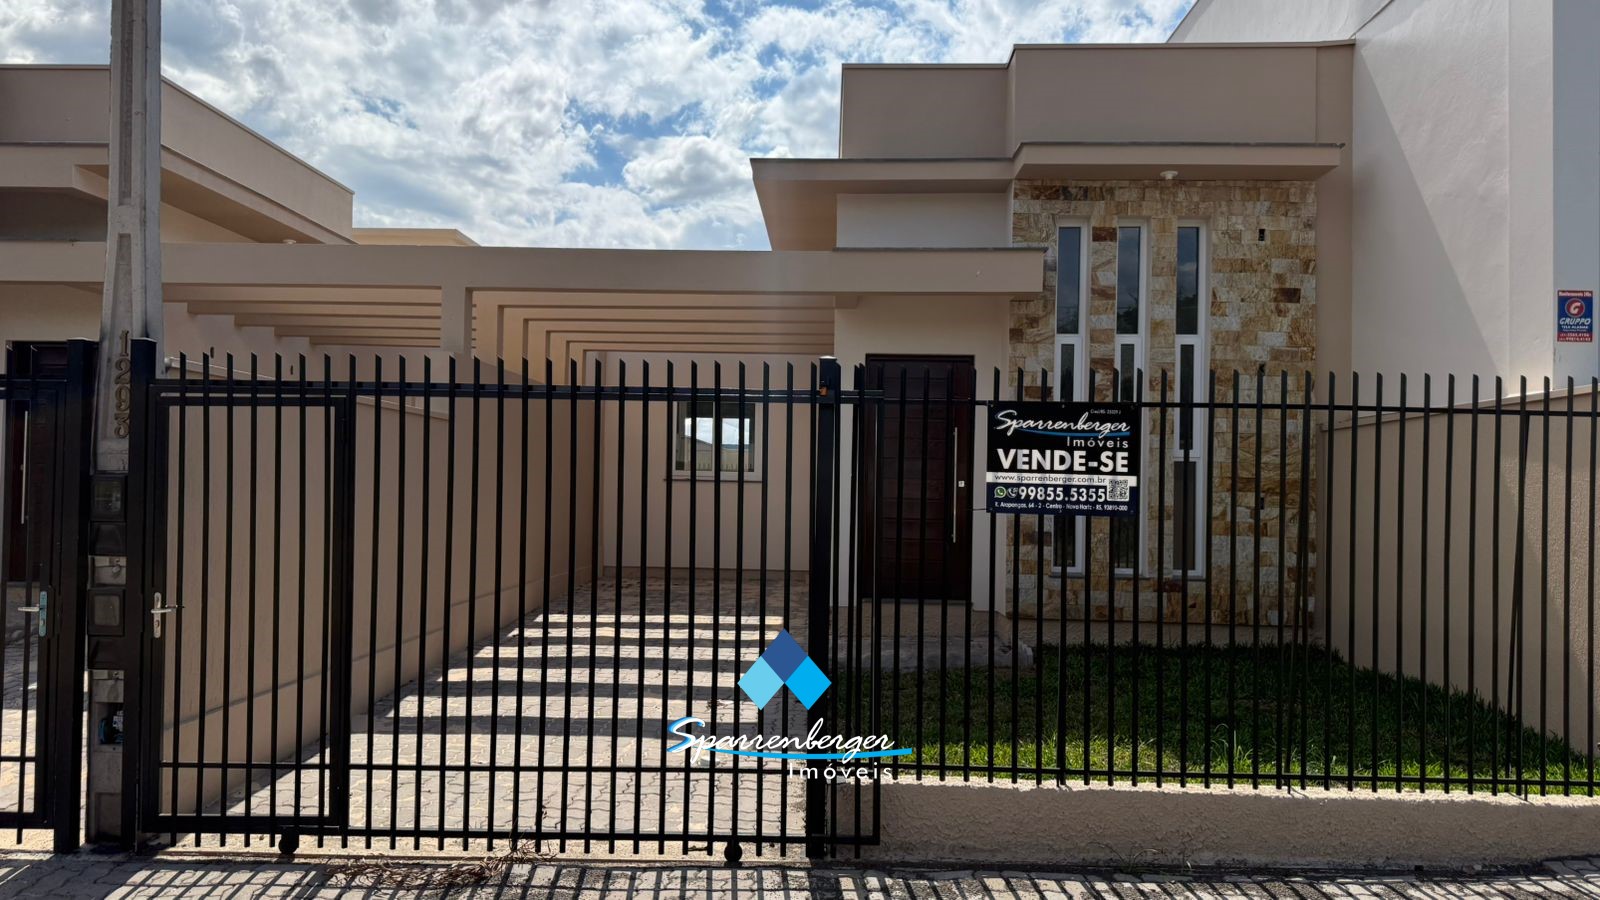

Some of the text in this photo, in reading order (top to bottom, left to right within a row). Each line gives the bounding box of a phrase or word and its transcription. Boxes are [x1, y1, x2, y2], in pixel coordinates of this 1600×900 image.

[114, 329, 131, 439] 1293
[994, 409, 1131, 438] Sparrenberger
[1066, 436, 1129, 449] Imóveis
[996, 448, 1129, 473] VENDE-SE
[994, 474, 1106, 484] www.sparrenberger.com.br
[1018, 486, 1106, 502] 99855.5355
